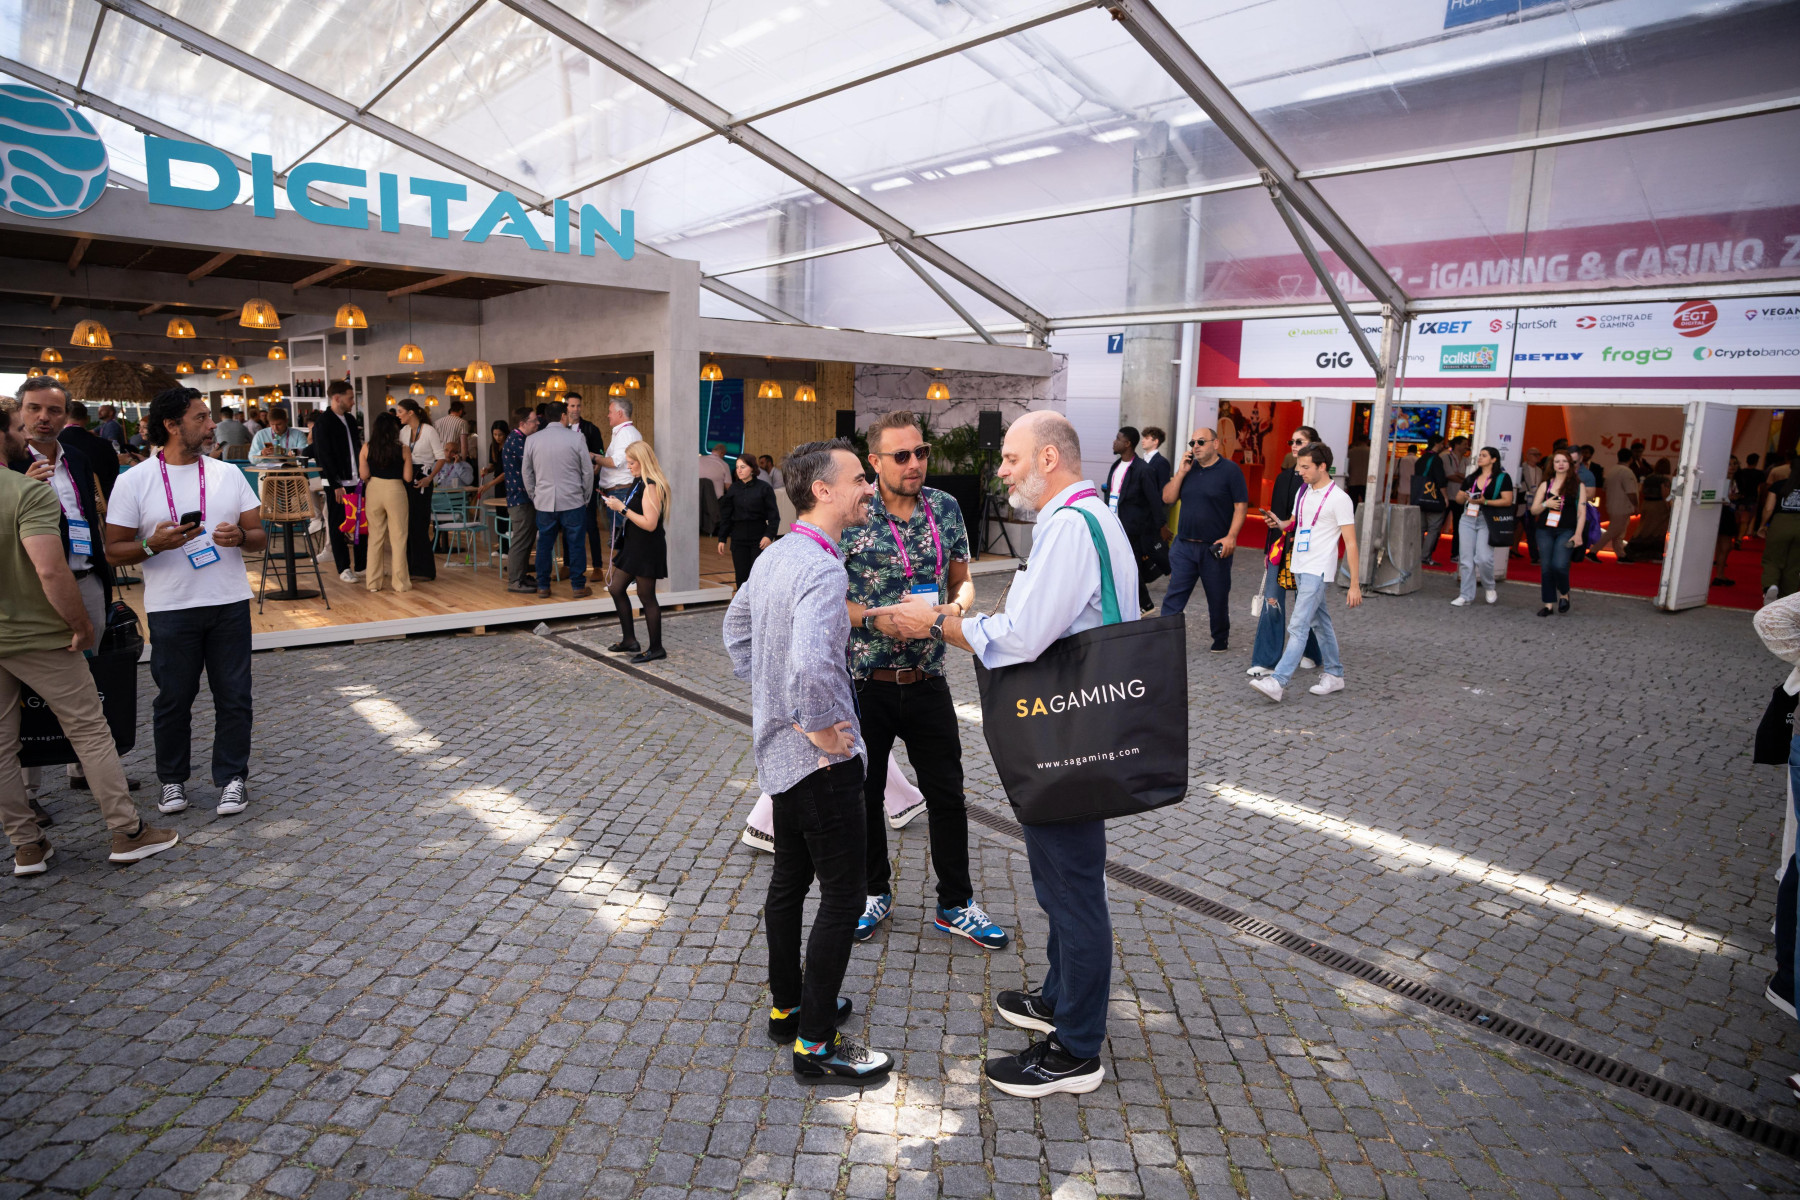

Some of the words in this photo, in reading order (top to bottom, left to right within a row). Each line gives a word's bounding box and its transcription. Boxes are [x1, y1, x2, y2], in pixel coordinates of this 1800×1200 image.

[144, 133, 636, 261] DIGITAIN
[1429, 254, 1570, 290] iGAMING
[1576, 250, 1607, 281] &
[1615, 238, 1764, 277] CASINO
[1600, 313, 1653, 322] COMTRADE
[1681, 310, 1710, 321] EGT
[1418, 320, 1472, 335] 1XBET
[1505, 319, 1557, 330] SmartSoft
[1599, 321, 1635, 329] GAMING
[1300, 328, 1339, 336] AMUSNET
[1112, 335, 1121, 351] 7
[1316, 351, 1353, 369] GiG
[1514, 352, 1584, 361] BETBY
[1036, 746, 1140, 769] www.sagaming.com
